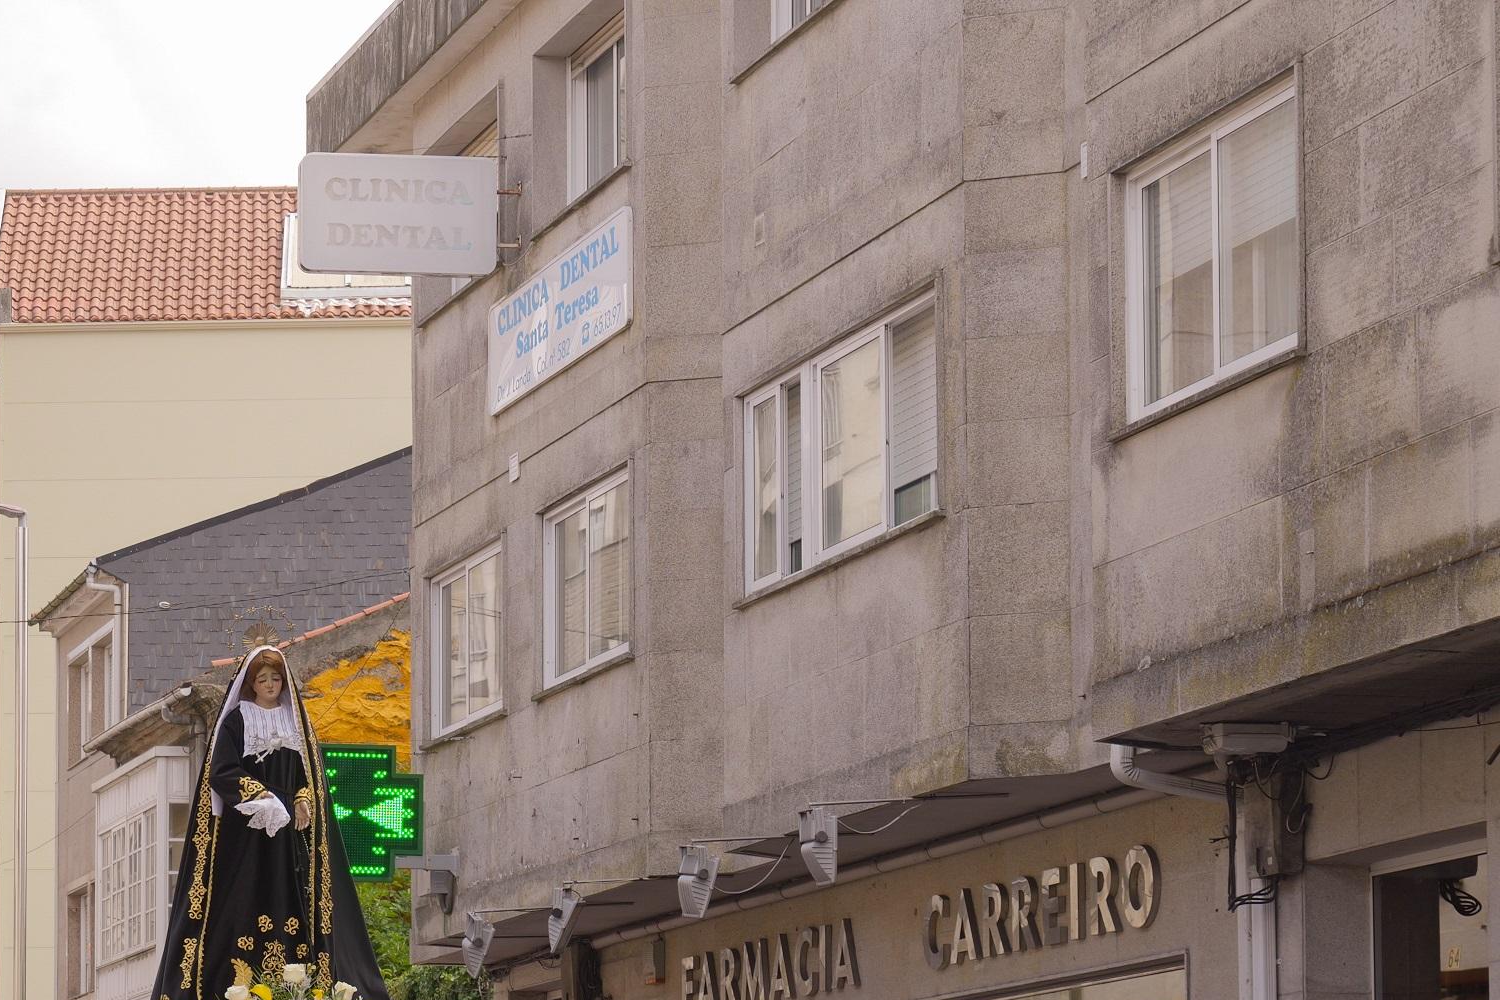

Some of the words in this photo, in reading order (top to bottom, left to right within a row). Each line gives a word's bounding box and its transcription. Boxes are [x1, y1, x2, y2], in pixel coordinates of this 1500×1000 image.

[325, 177, 474, 205] CLINICA
[326, 222, 472, 250] DENTAL
[497, 278, 549, 336] CLINICA
[560, 226, 619, 291] DENTAL
[516, 319, 549, 358] Santa
[555, 286, 598, 330] Teresa
[923, 844, 1162, 971] CARREIRO
